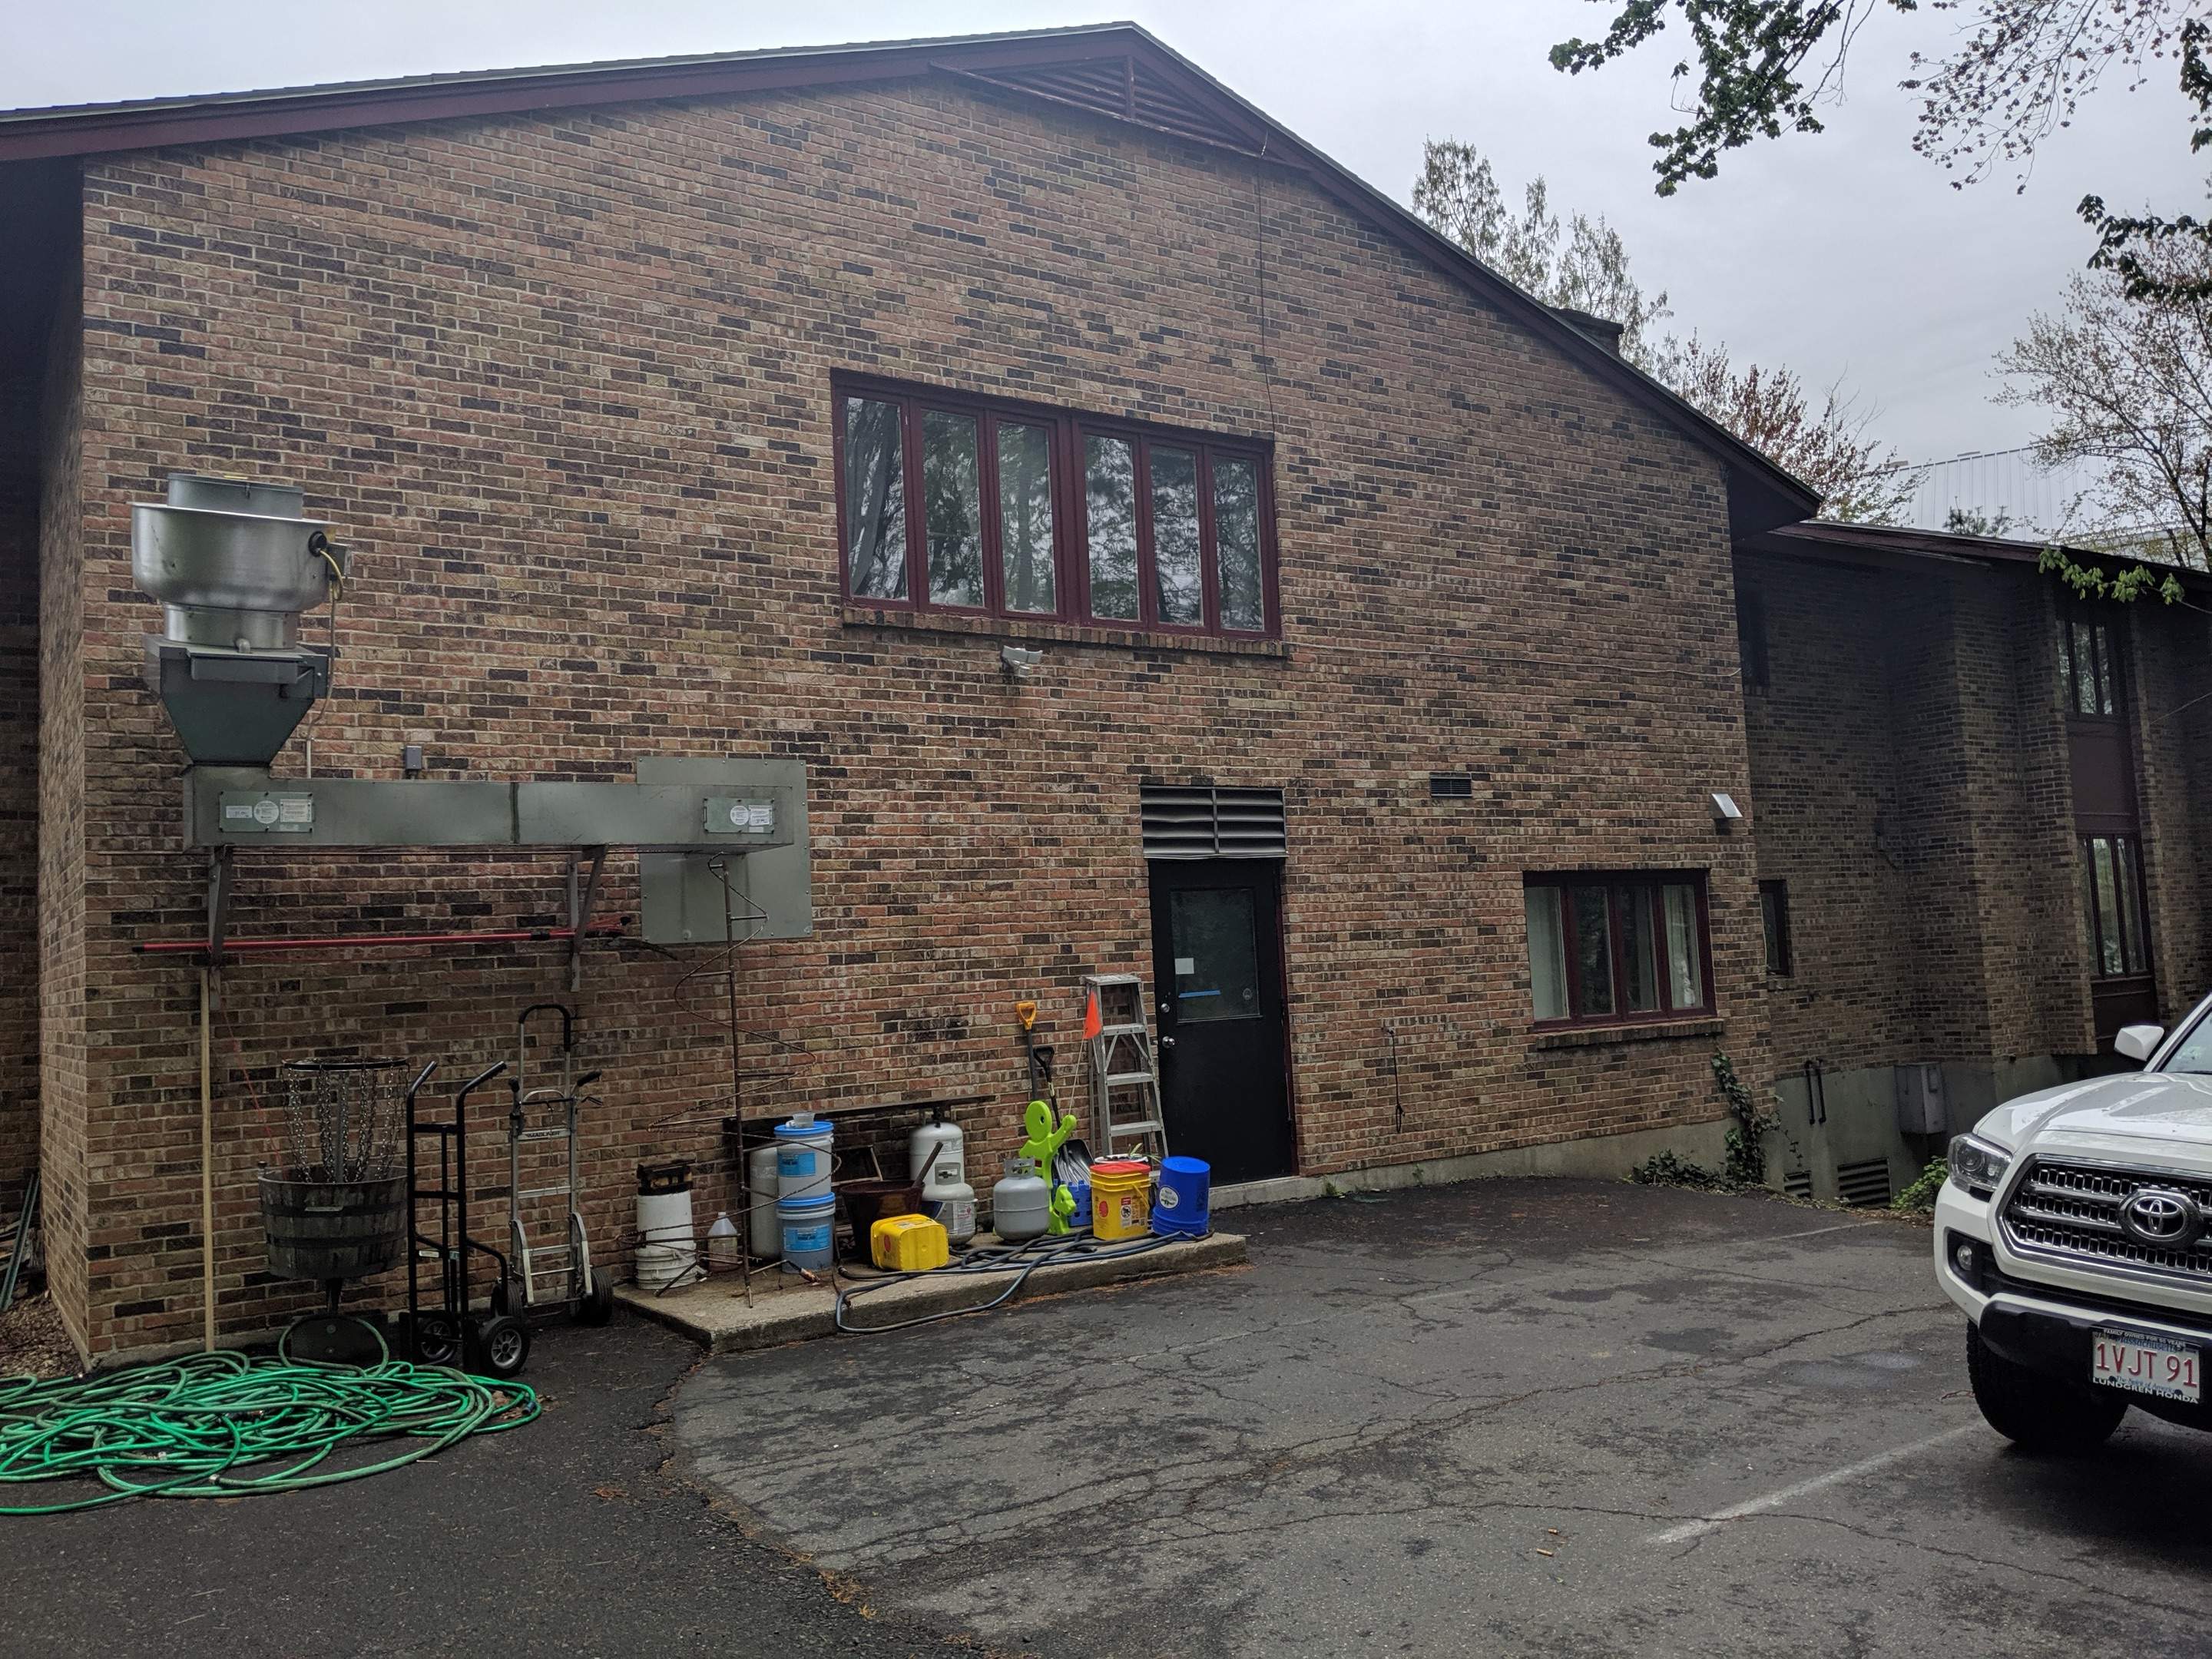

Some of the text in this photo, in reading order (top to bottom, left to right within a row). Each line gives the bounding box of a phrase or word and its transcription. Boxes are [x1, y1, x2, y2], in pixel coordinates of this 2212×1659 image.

[2095, 1342, 2198, 1388] 1VJT 91
[2092, 1376, 2199, 1404] LUNDGREN HONDA
